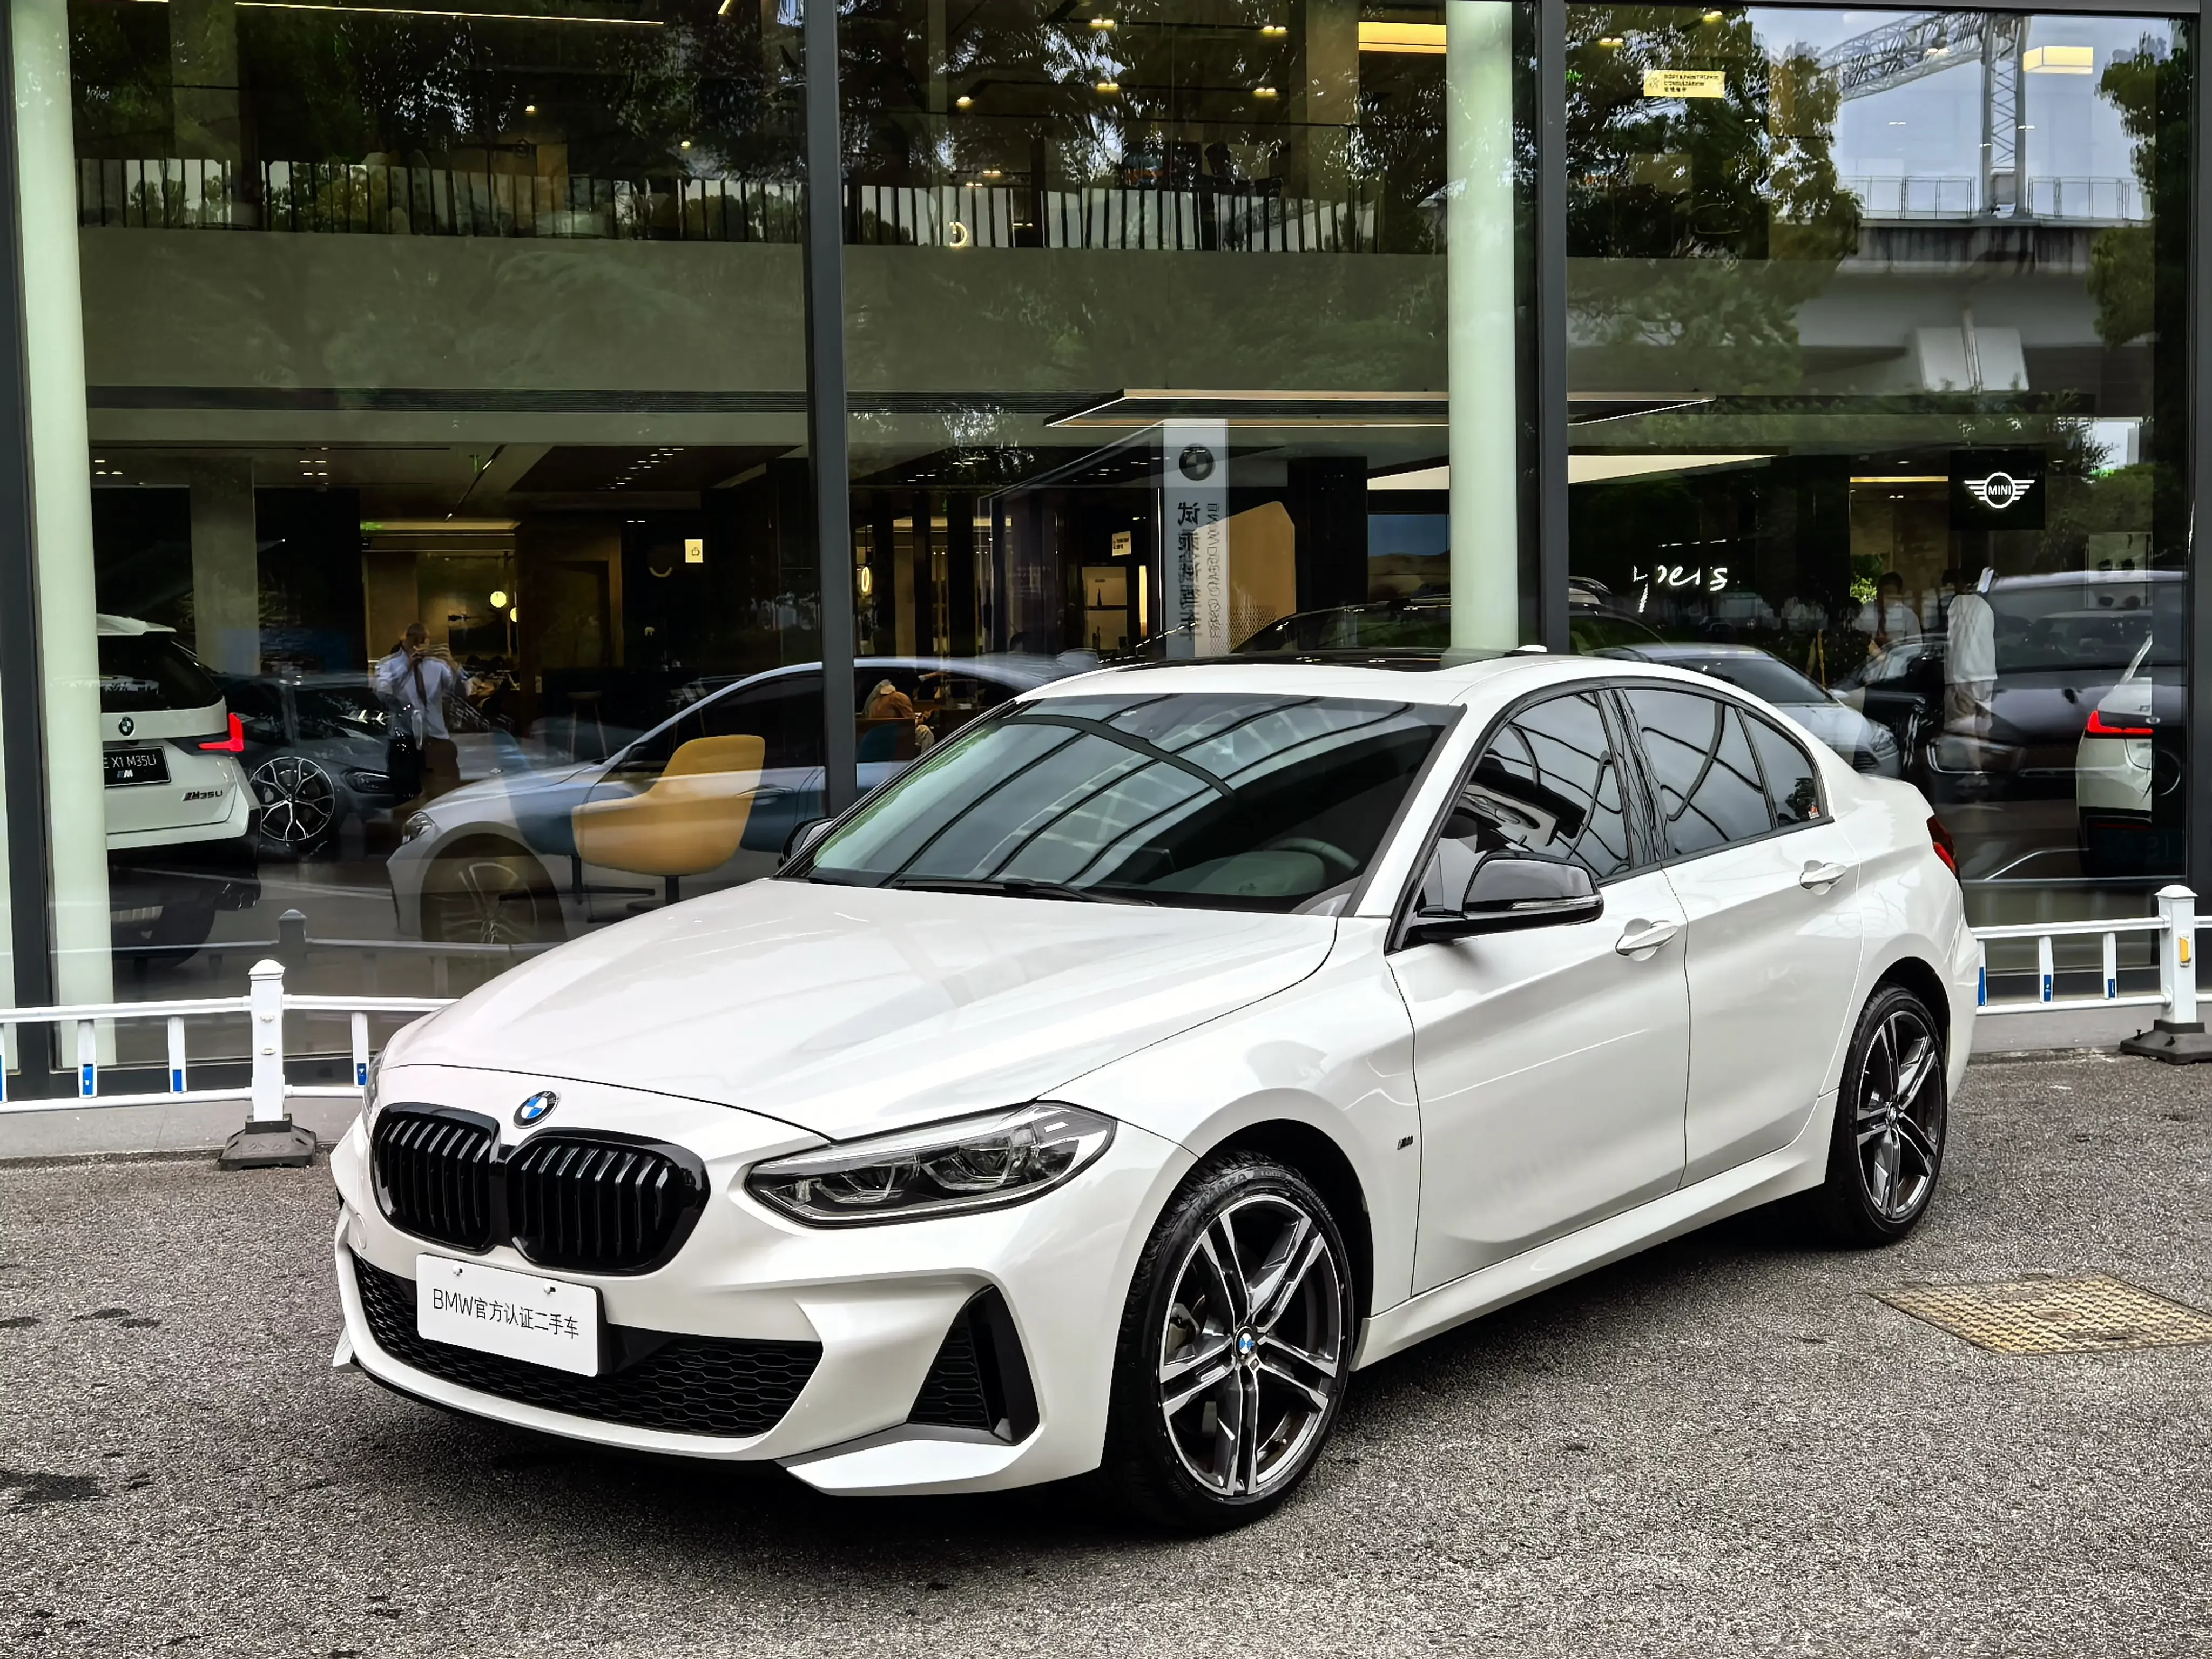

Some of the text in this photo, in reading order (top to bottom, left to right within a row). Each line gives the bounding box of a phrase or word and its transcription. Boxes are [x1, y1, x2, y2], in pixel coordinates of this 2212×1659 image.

[1988, 484, 2011, 495] MINI
[111, 756, 124, 768] X1
[433, 1288, 579, 1339] BMW官方认证二手车
